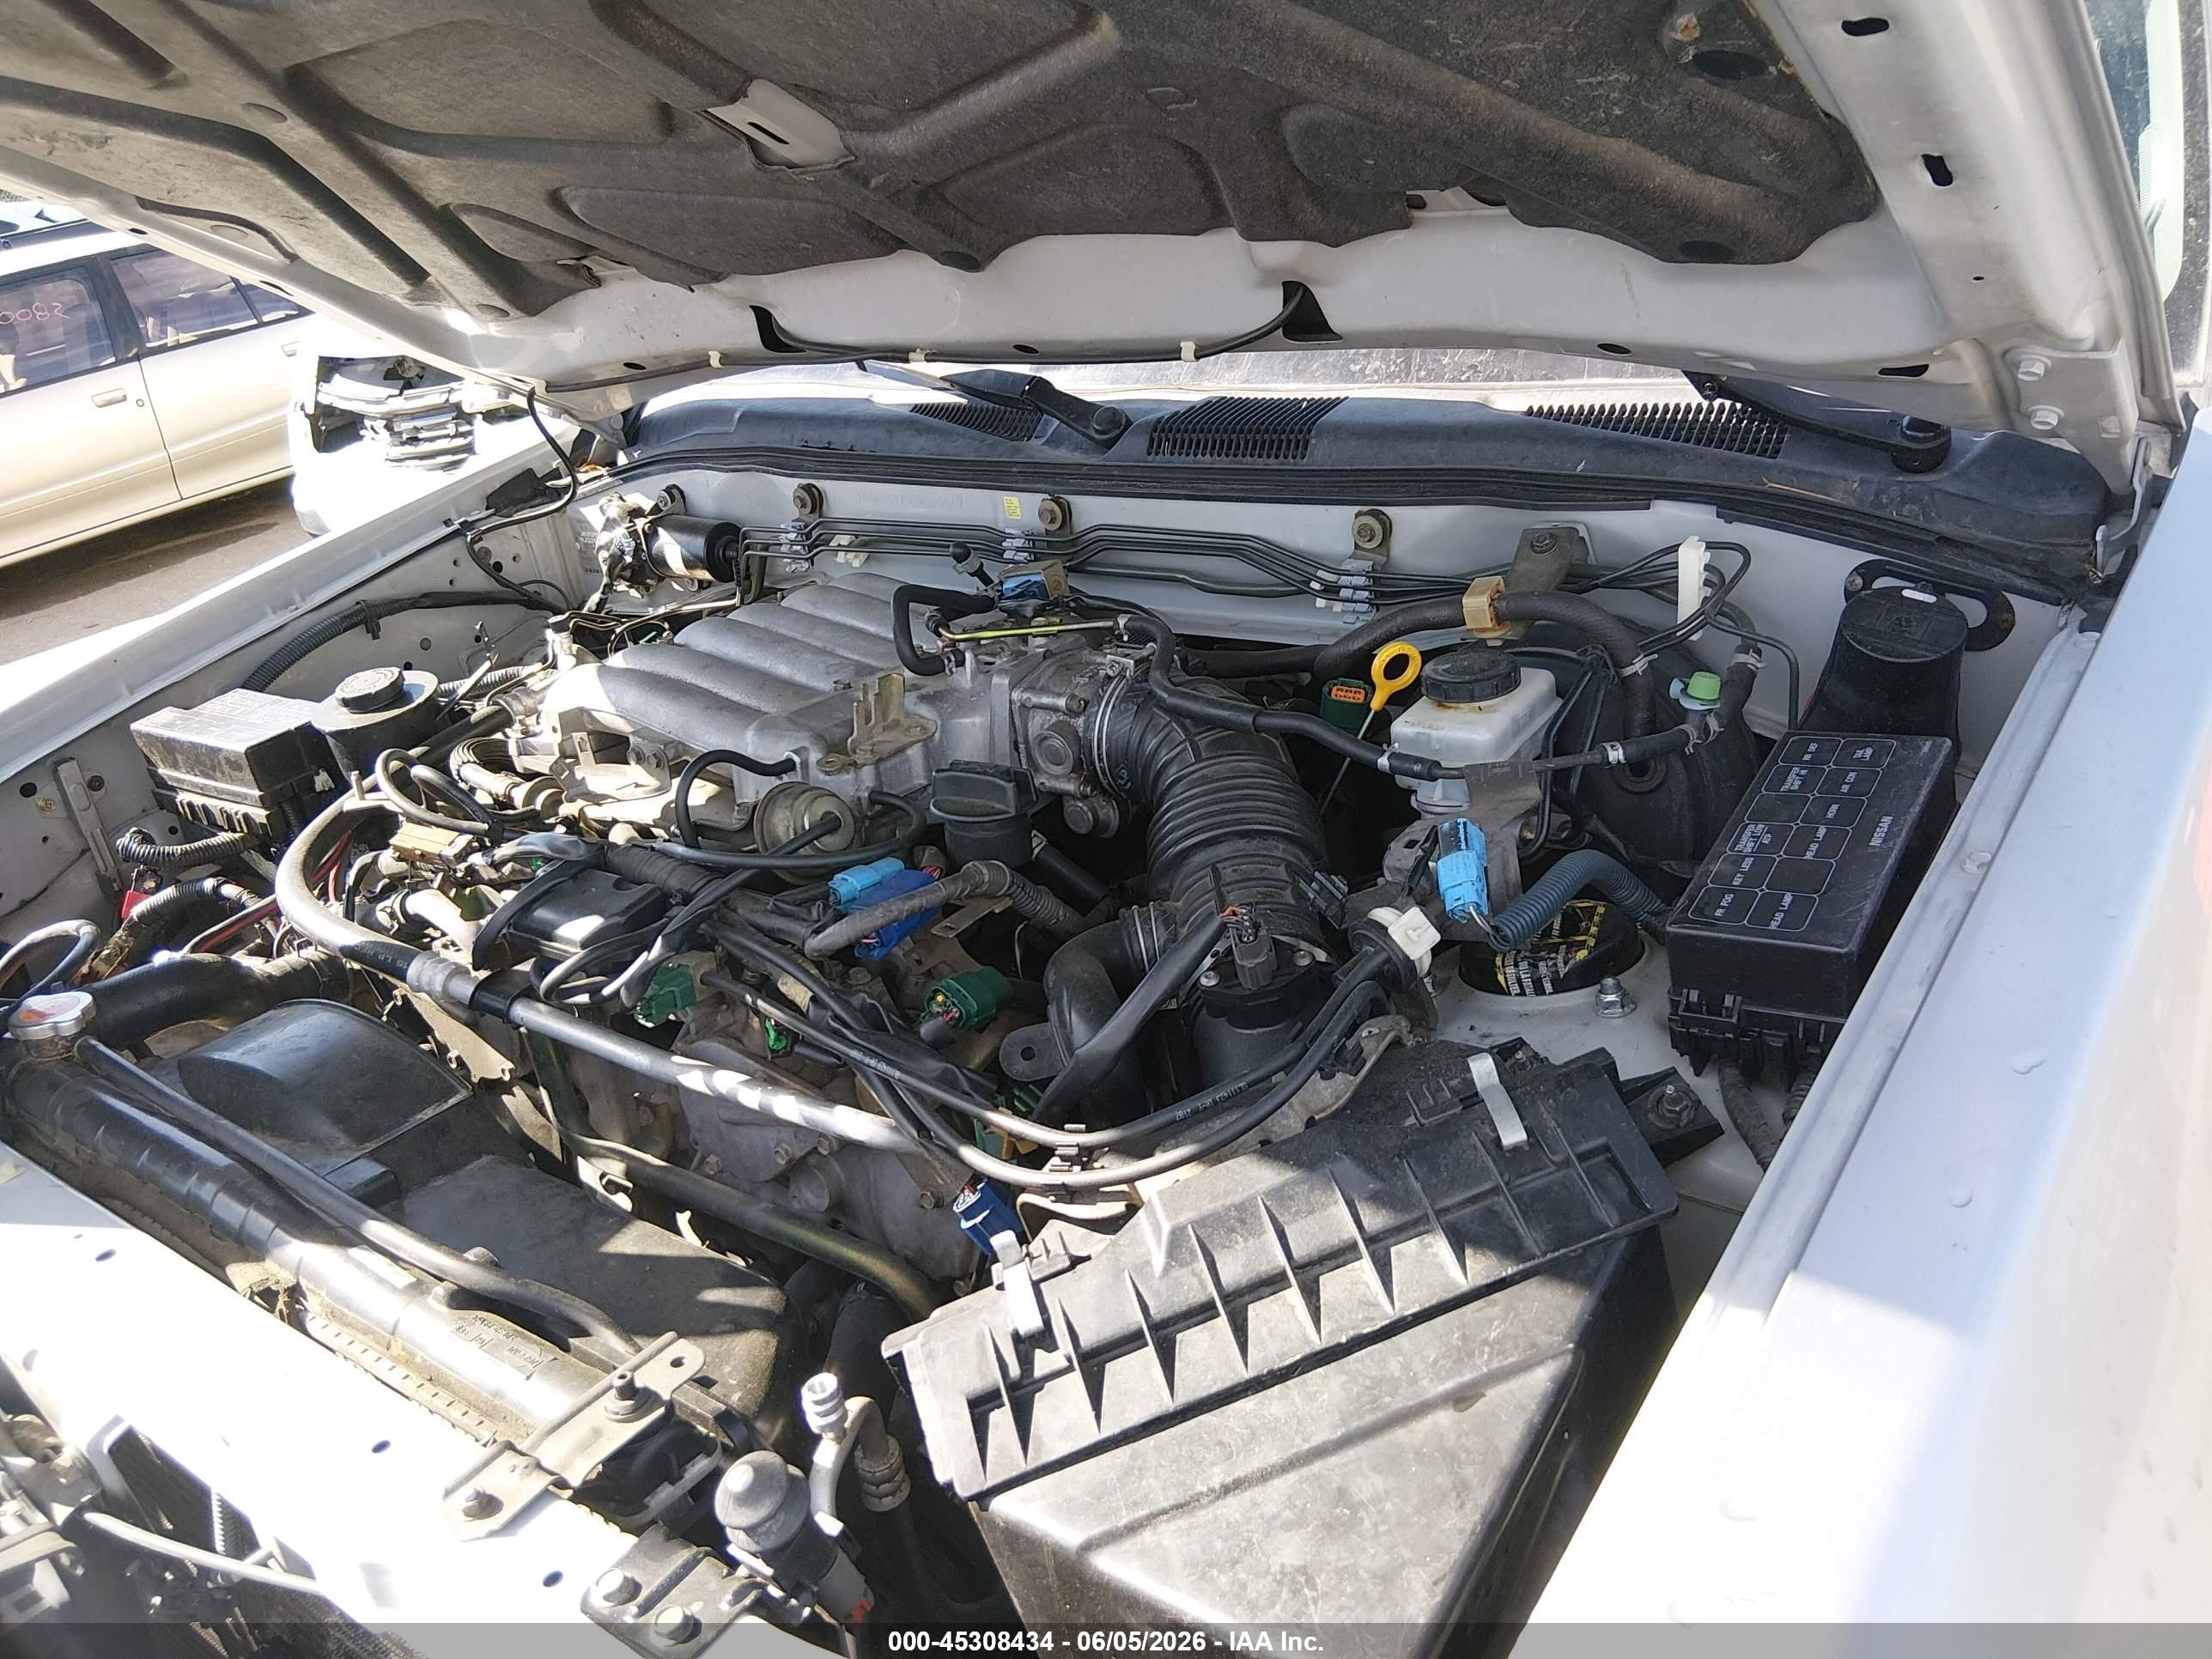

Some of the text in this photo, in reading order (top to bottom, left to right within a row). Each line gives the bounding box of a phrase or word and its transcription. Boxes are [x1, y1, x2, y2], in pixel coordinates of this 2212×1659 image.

[1808, 743, 1818, 752] DEF
[1861, 747, 1874, 761] LAMP
[1780, 767, 1797, 792] TRANSFER
[1845, 772, 1856, 782] CON
[1826, 804, 1839, 818] HORN
[1735, 824, 1757, 851] TRANSFER
[1743, 824, 1765, 853] SHIFT LOW
[1762, 833, 1773, 844] ATP
[1804, 825, 1827, 859] HEAD LAMP
[1869, 816, 1893, 846] NISSAN
[1731, 857, 1753, 885] KEY LESS
[1720, 894, 1734, 907] FOG
[1770, 893, 1793, 928] HEAD LAMP
